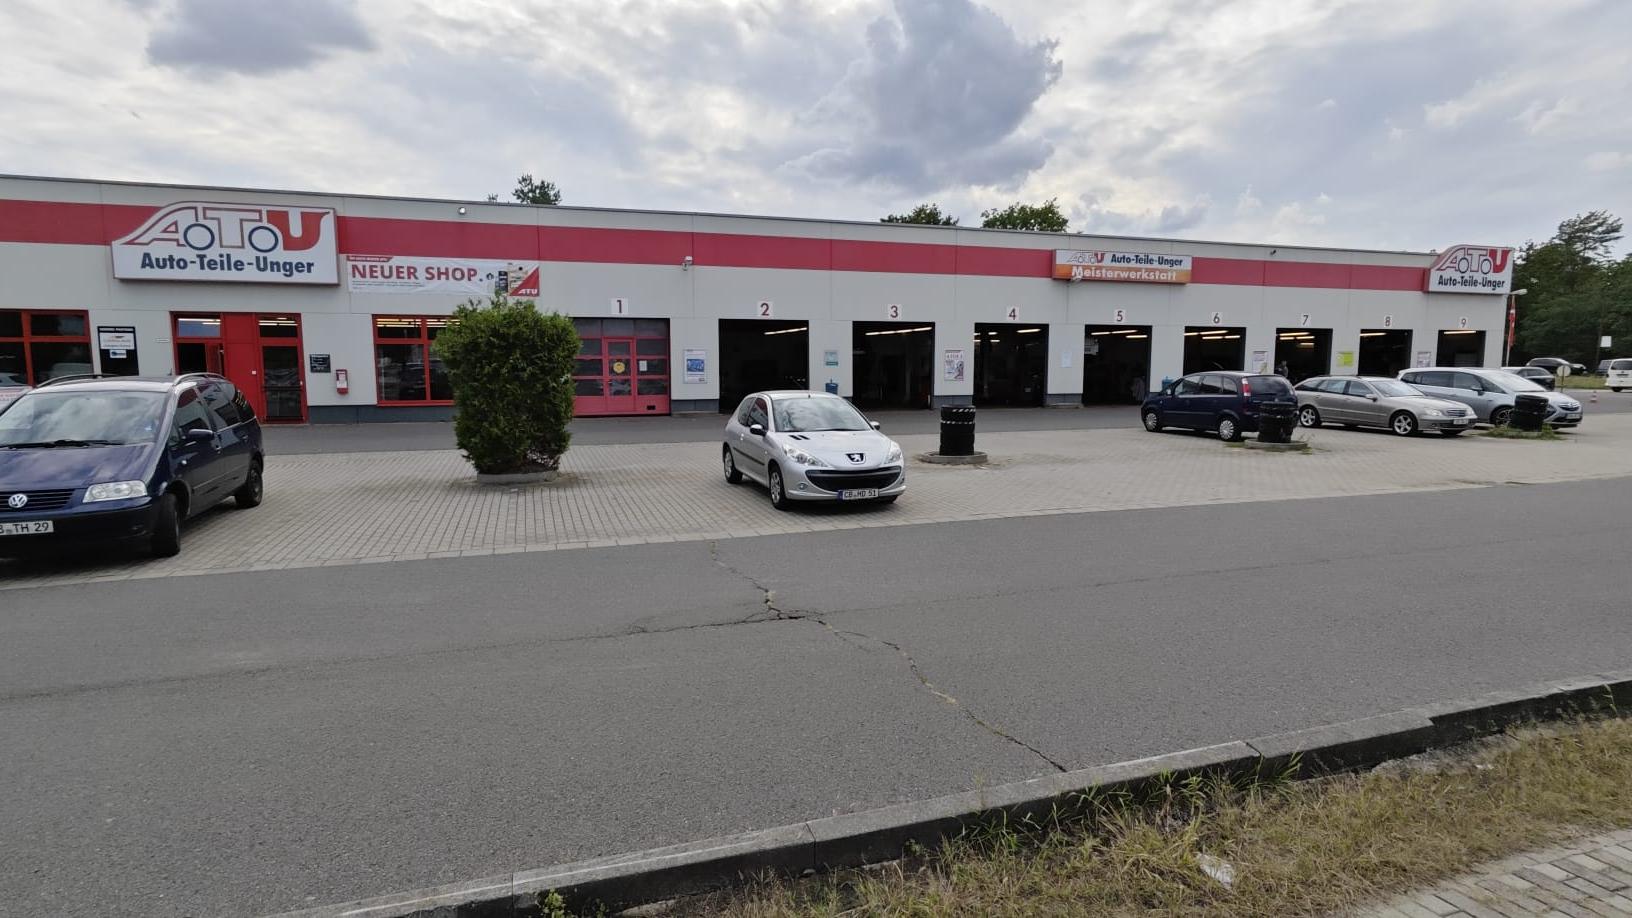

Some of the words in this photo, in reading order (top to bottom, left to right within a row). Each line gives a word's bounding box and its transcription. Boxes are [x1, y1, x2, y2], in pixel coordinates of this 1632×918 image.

[140, 252, 314, 277] Auto-Teile-Unger
[1111, 253, 1183, 267] Auto-Teile-Unger
[352, 264, 418, 280] NEUER
[1072, 265, 1177, 280] Meisterwerkstatt
[1438, 275, 1505, 290] Auto-Teile-Unger
[616, 299, 623, 314] 1
[760, 302, 770, 317] 2
[890, 305, 899, 318] 3
[1008, 308, 1017, 320] 4
[1116, 310, 1123, 322] 5
[1213, 312, 1220, 324] 6
[1303, 314, 1310, 326] 7
[1384, 316, 1391, 327] 8
[1461, 318, 1467, 328] 9
[13, 523, 29, 533] TH
[34, 522, 49, 532] 29
